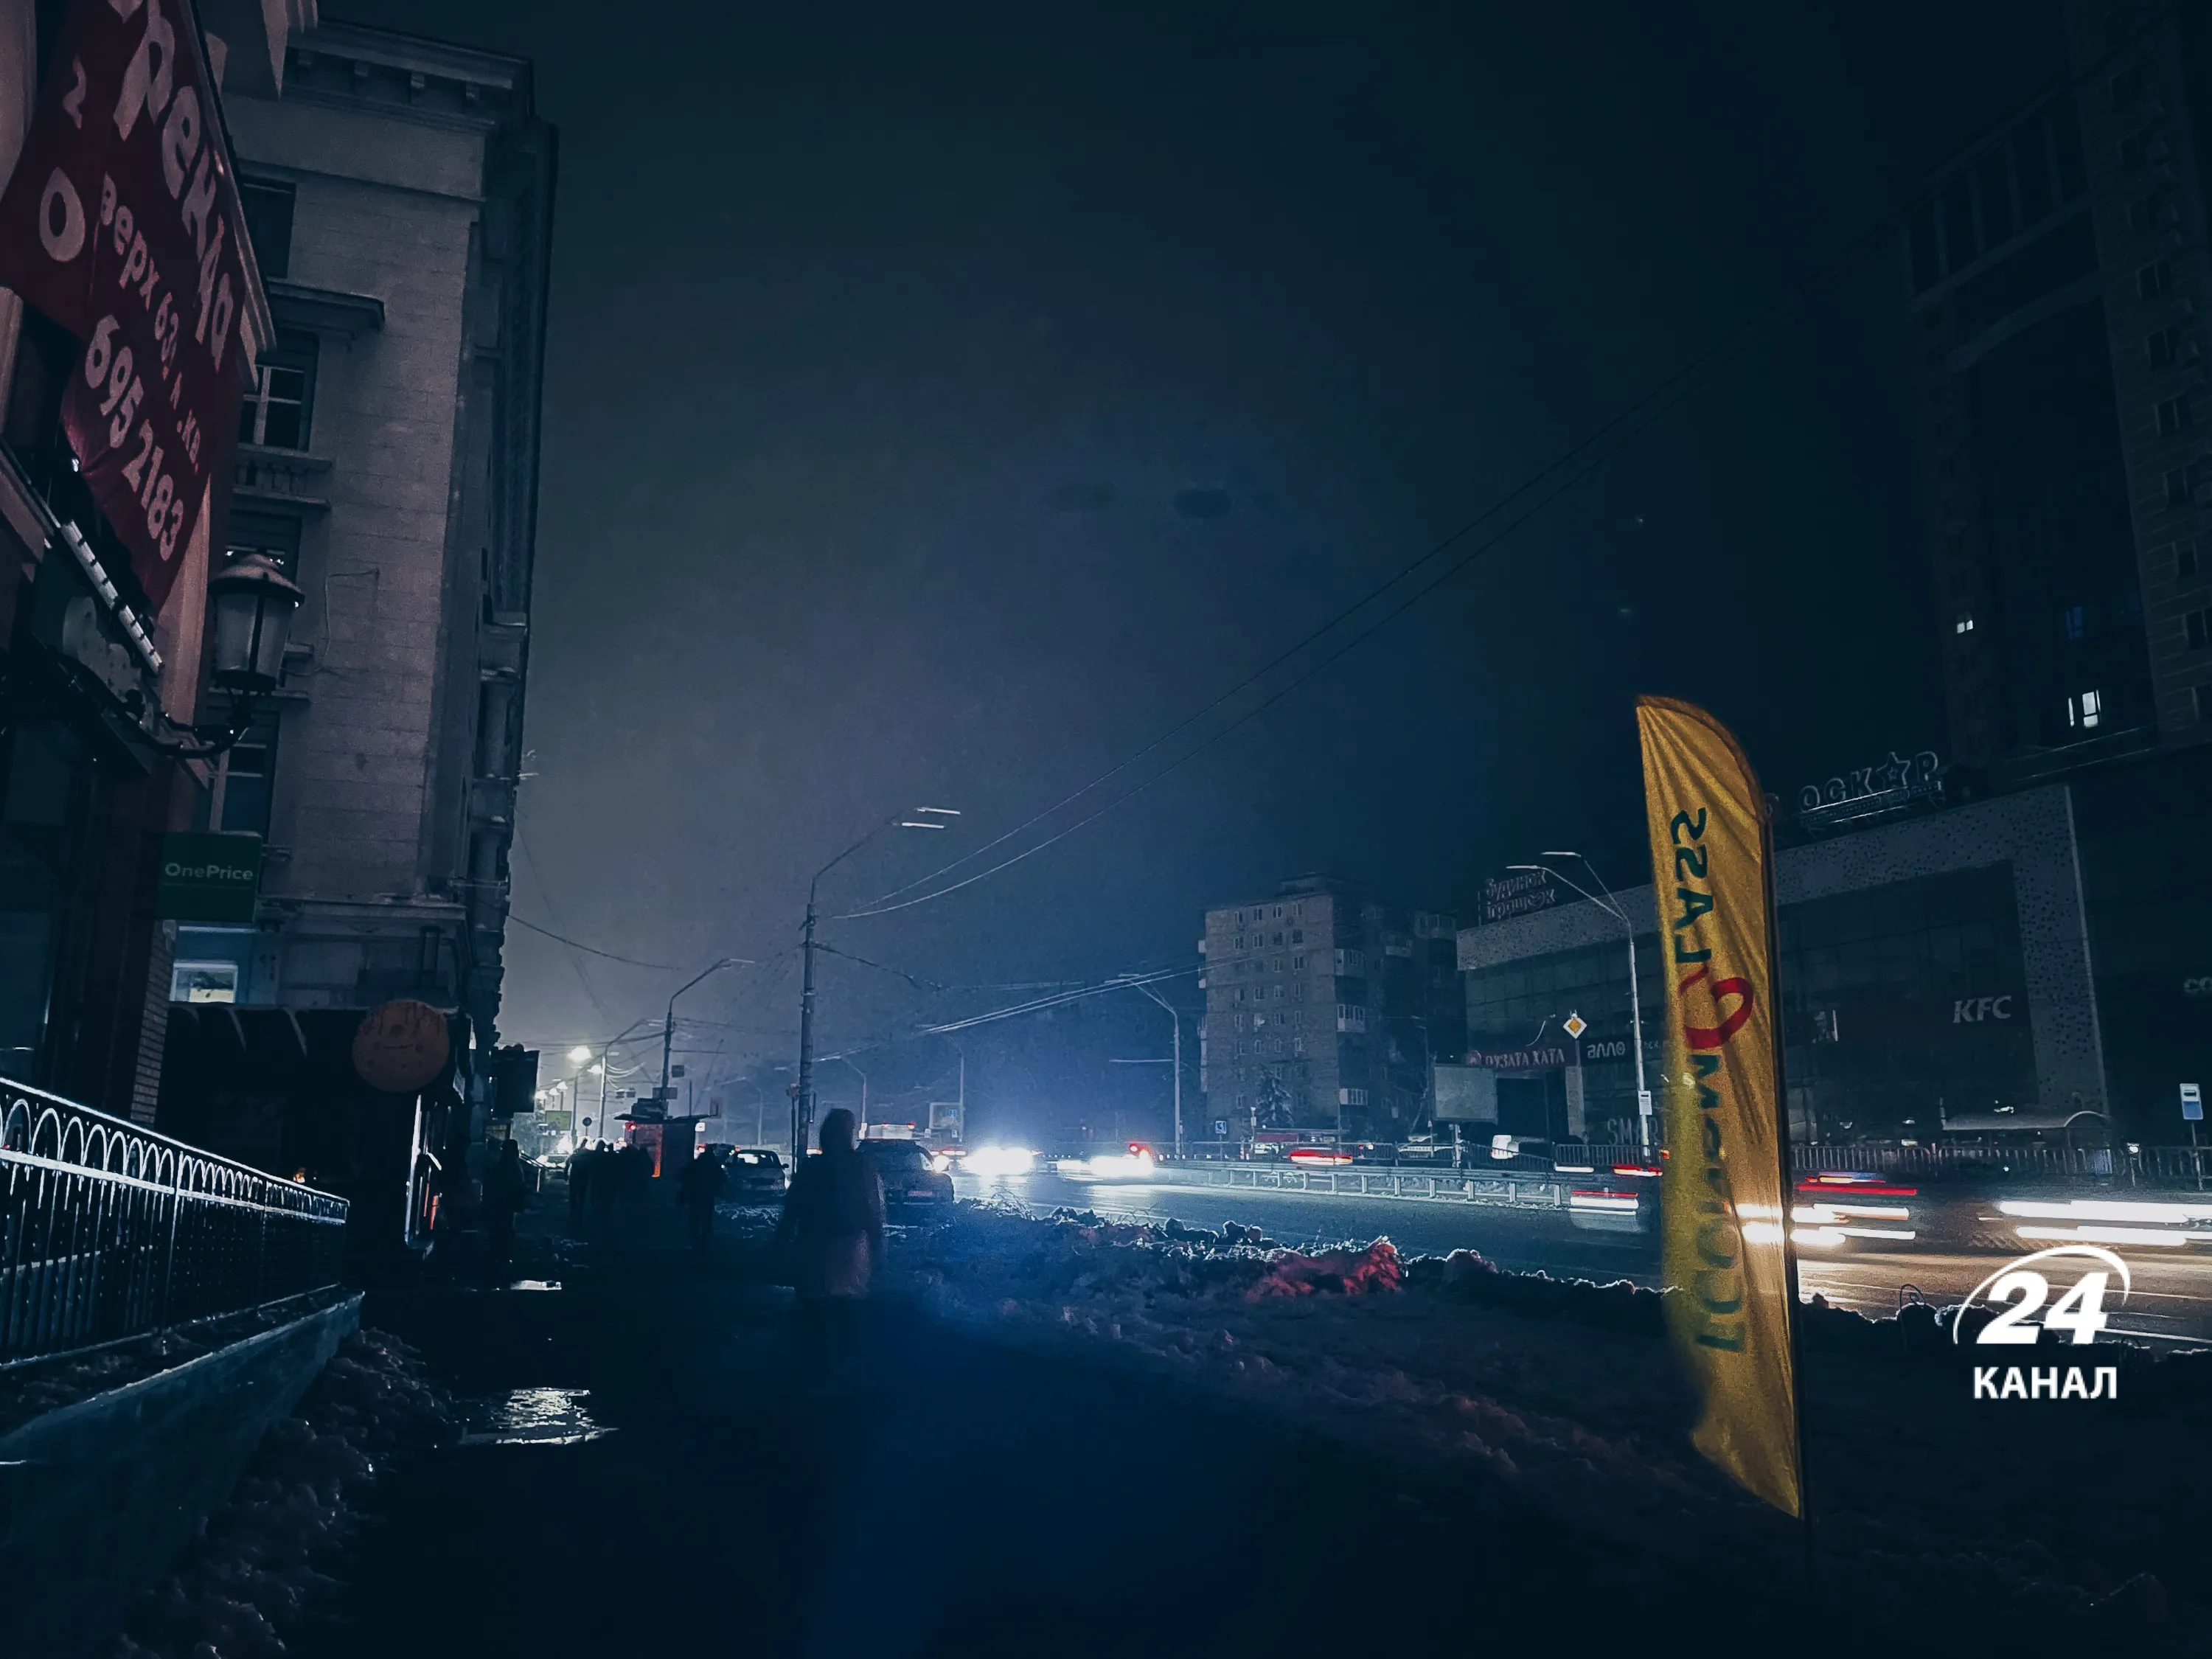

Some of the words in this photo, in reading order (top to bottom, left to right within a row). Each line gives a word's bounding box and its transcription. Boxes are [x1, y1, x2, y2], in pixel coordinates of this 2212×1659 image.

[107, 0, 238, 373] ренда
[164, 862, 254, 880] OnePrice
[1952, 995, 2012, 1023] KFC
